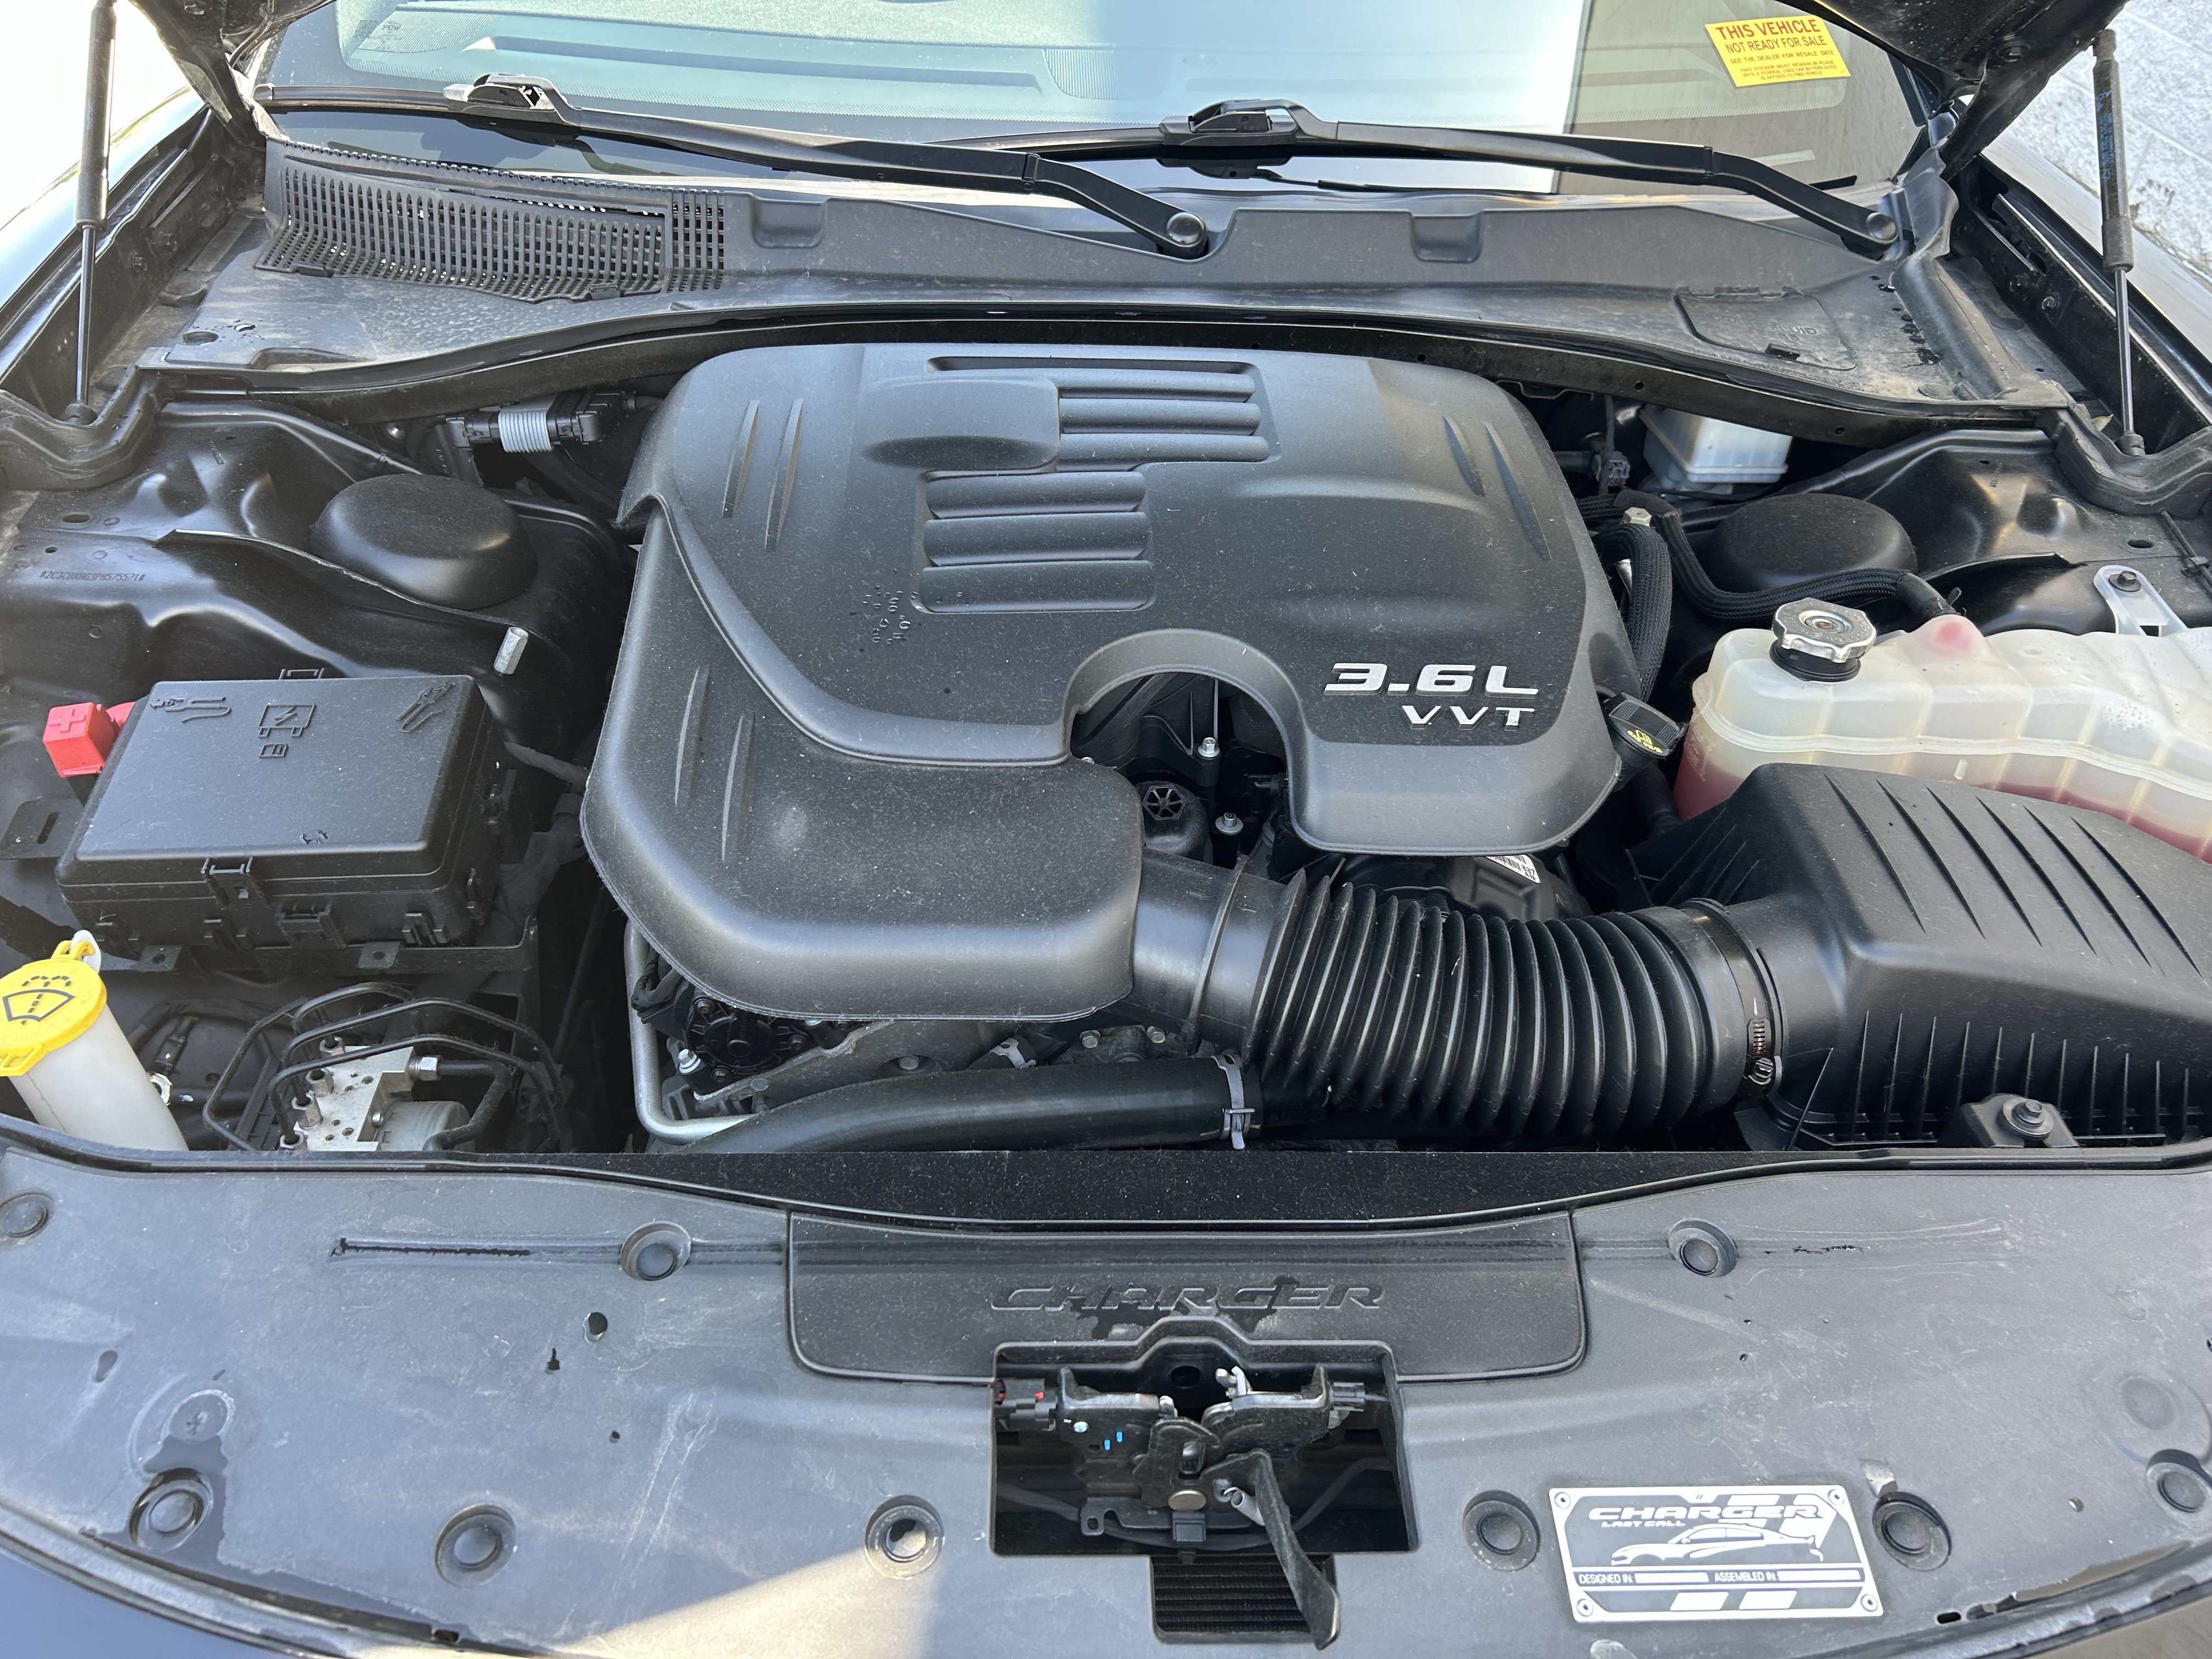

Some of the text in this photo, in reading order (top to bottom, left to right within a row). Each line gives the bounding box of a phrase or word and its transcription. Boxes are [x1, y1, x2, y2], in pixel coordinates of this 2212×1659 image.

[1715, 19, 1821, 40] THIS VEHICLE
[1725, 35, 1827, 54] NOT READY FOR SALE
[1323, 662, 1539, 699] 3.6L
[1401, 704, 1536, 731] VVT
[990, 1283, 1385, 1312] CHARGER
[1589, 1505, 1824, 1520] CHARGER
[1578, 1573, 1621, 1584] DESIGNED
[1714, 1571, 1765, 1582] ASSEMBLED
